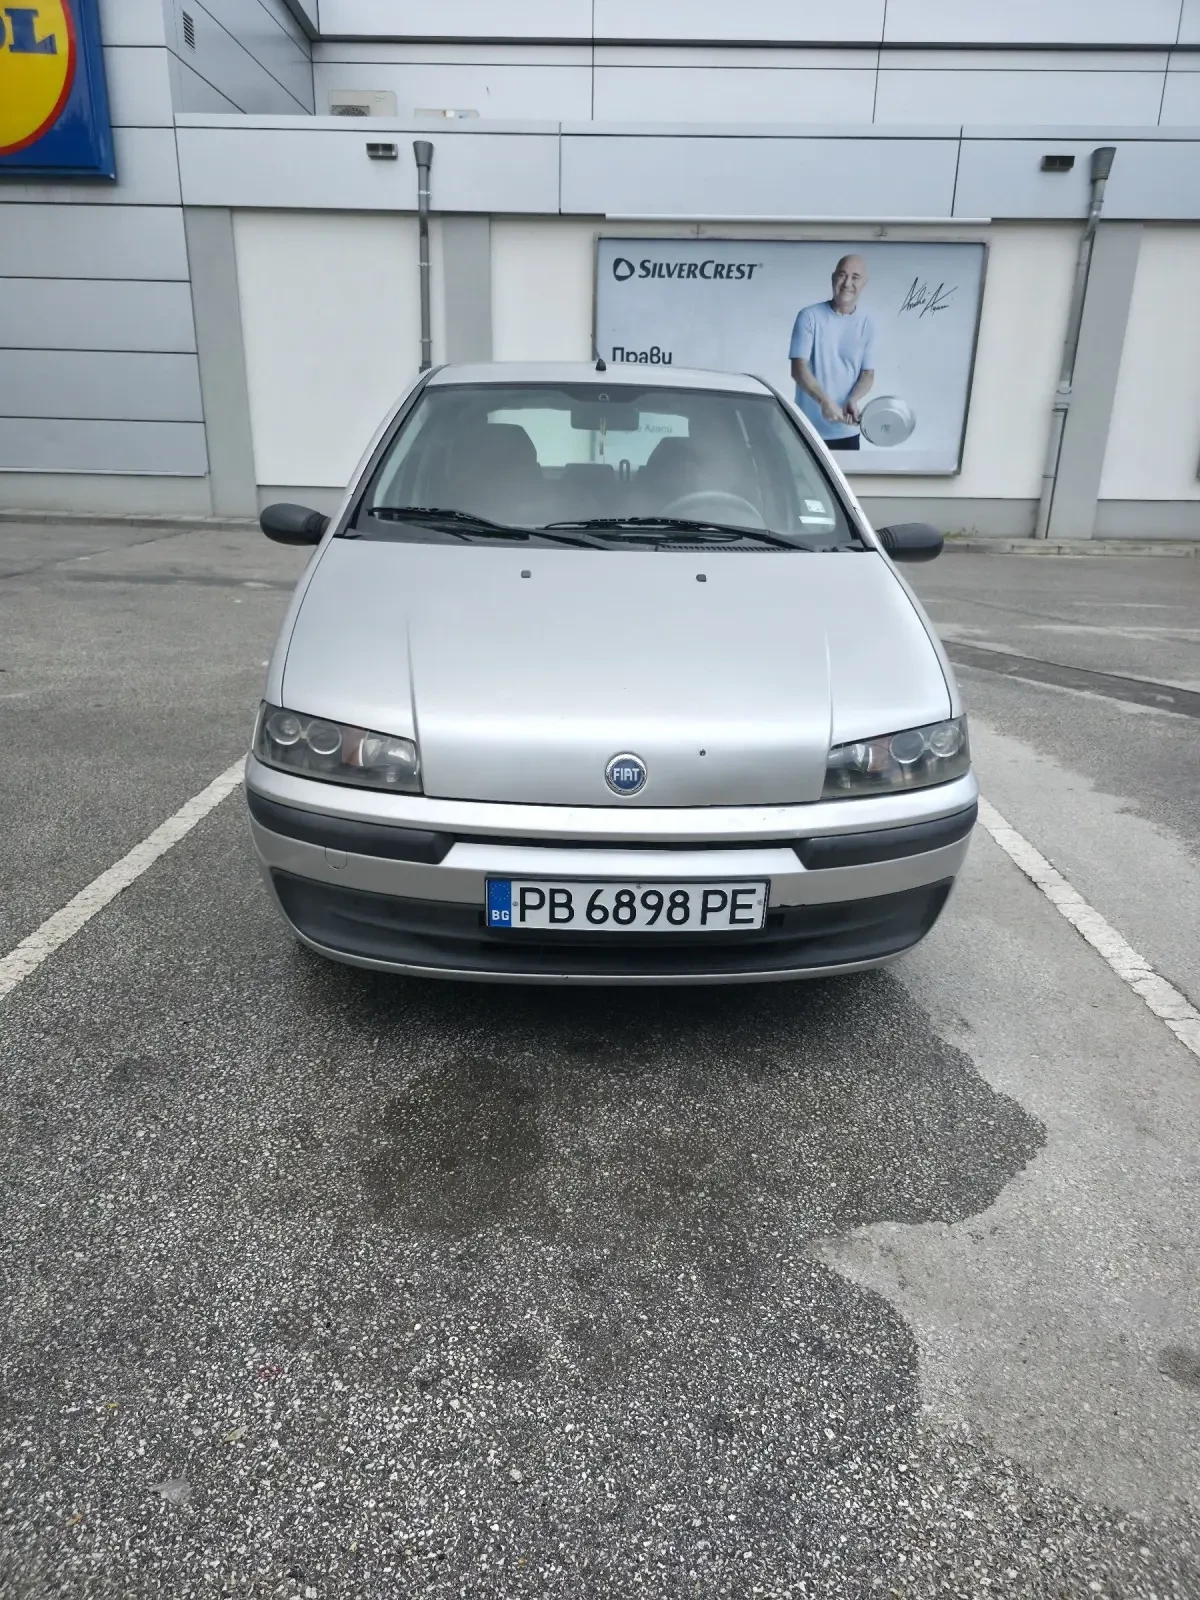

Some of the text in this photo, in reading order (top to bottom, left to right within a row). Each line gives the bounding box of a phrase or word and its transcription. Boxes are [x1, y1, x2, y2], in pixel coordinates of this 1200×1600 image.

[612, 346, 673, 365] Прави
[613, 768, 640, 781] FIAT
[519, 886, 757, 926] PB 6898 PE
[491, 909, 510, 921] BG
